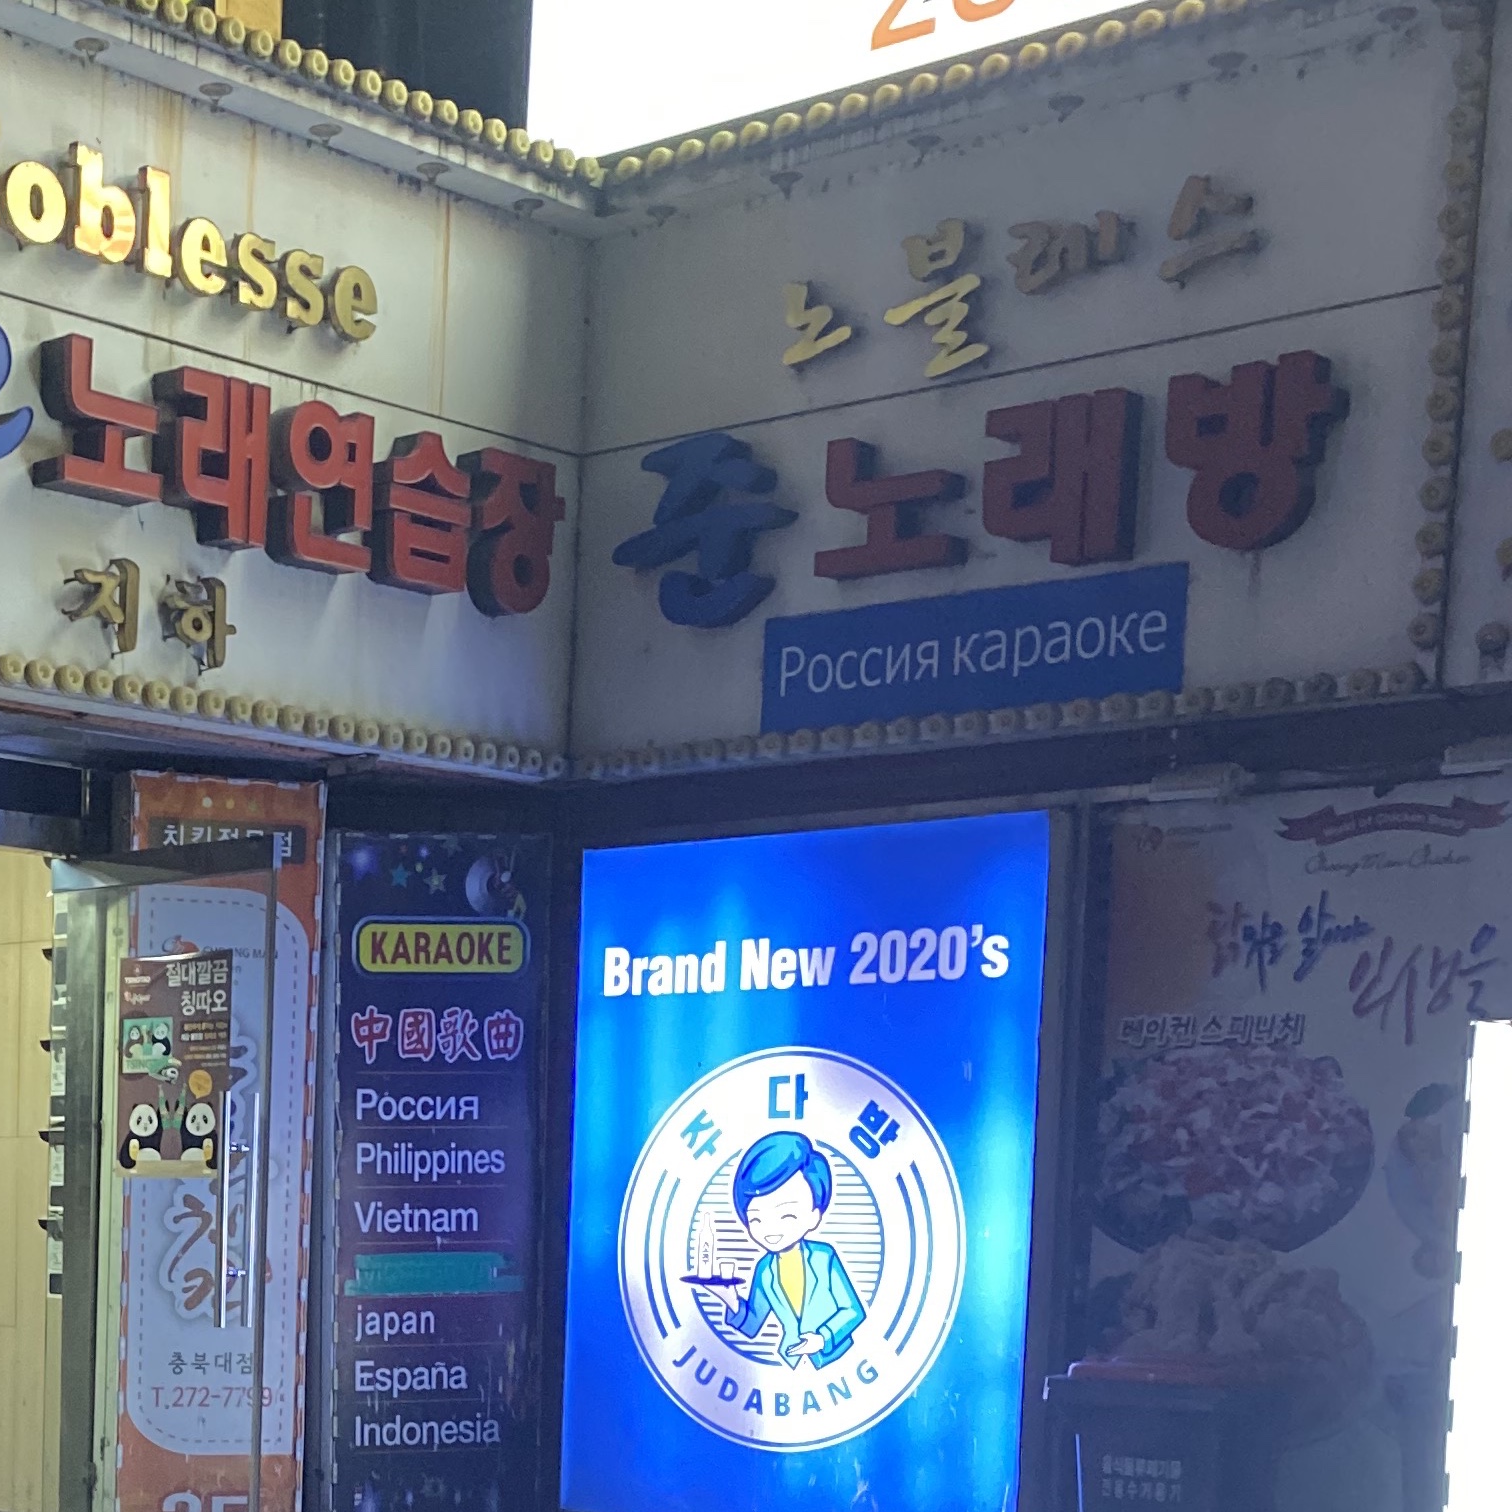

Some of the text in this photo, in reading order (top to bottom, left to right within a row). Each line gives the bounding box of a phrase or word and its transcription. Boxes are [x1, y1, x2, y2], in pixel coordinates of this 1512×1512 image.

[32, 331, 567, 618] 노래연습장
[778, 604, 1169, 697] Россия караоке
[371, 931, 512, 966] KARAOKE
[166, 959, 229, 988] 절대깔끔
[603, 938, 727, 998] Brand
[740, 938, 835, 991] New
[181, 989, 228, 1016] 칭따오
[351, 1005, 525, 1064] 中國歌曲
[355, 1088, 480, 1122] Россия
[679, 1073, 902, 1161] 주다방
[356, 1142, 506, 1182] Philippines
[354, 1201, 479, 1234] Vietnam
[355, 1305, 436, 1342] japan
[355, 1360, 469, 1398] España
[672, 1344, 880, 1418] JUDABANG
[355, 1412, 501, 1447] Indonesia
